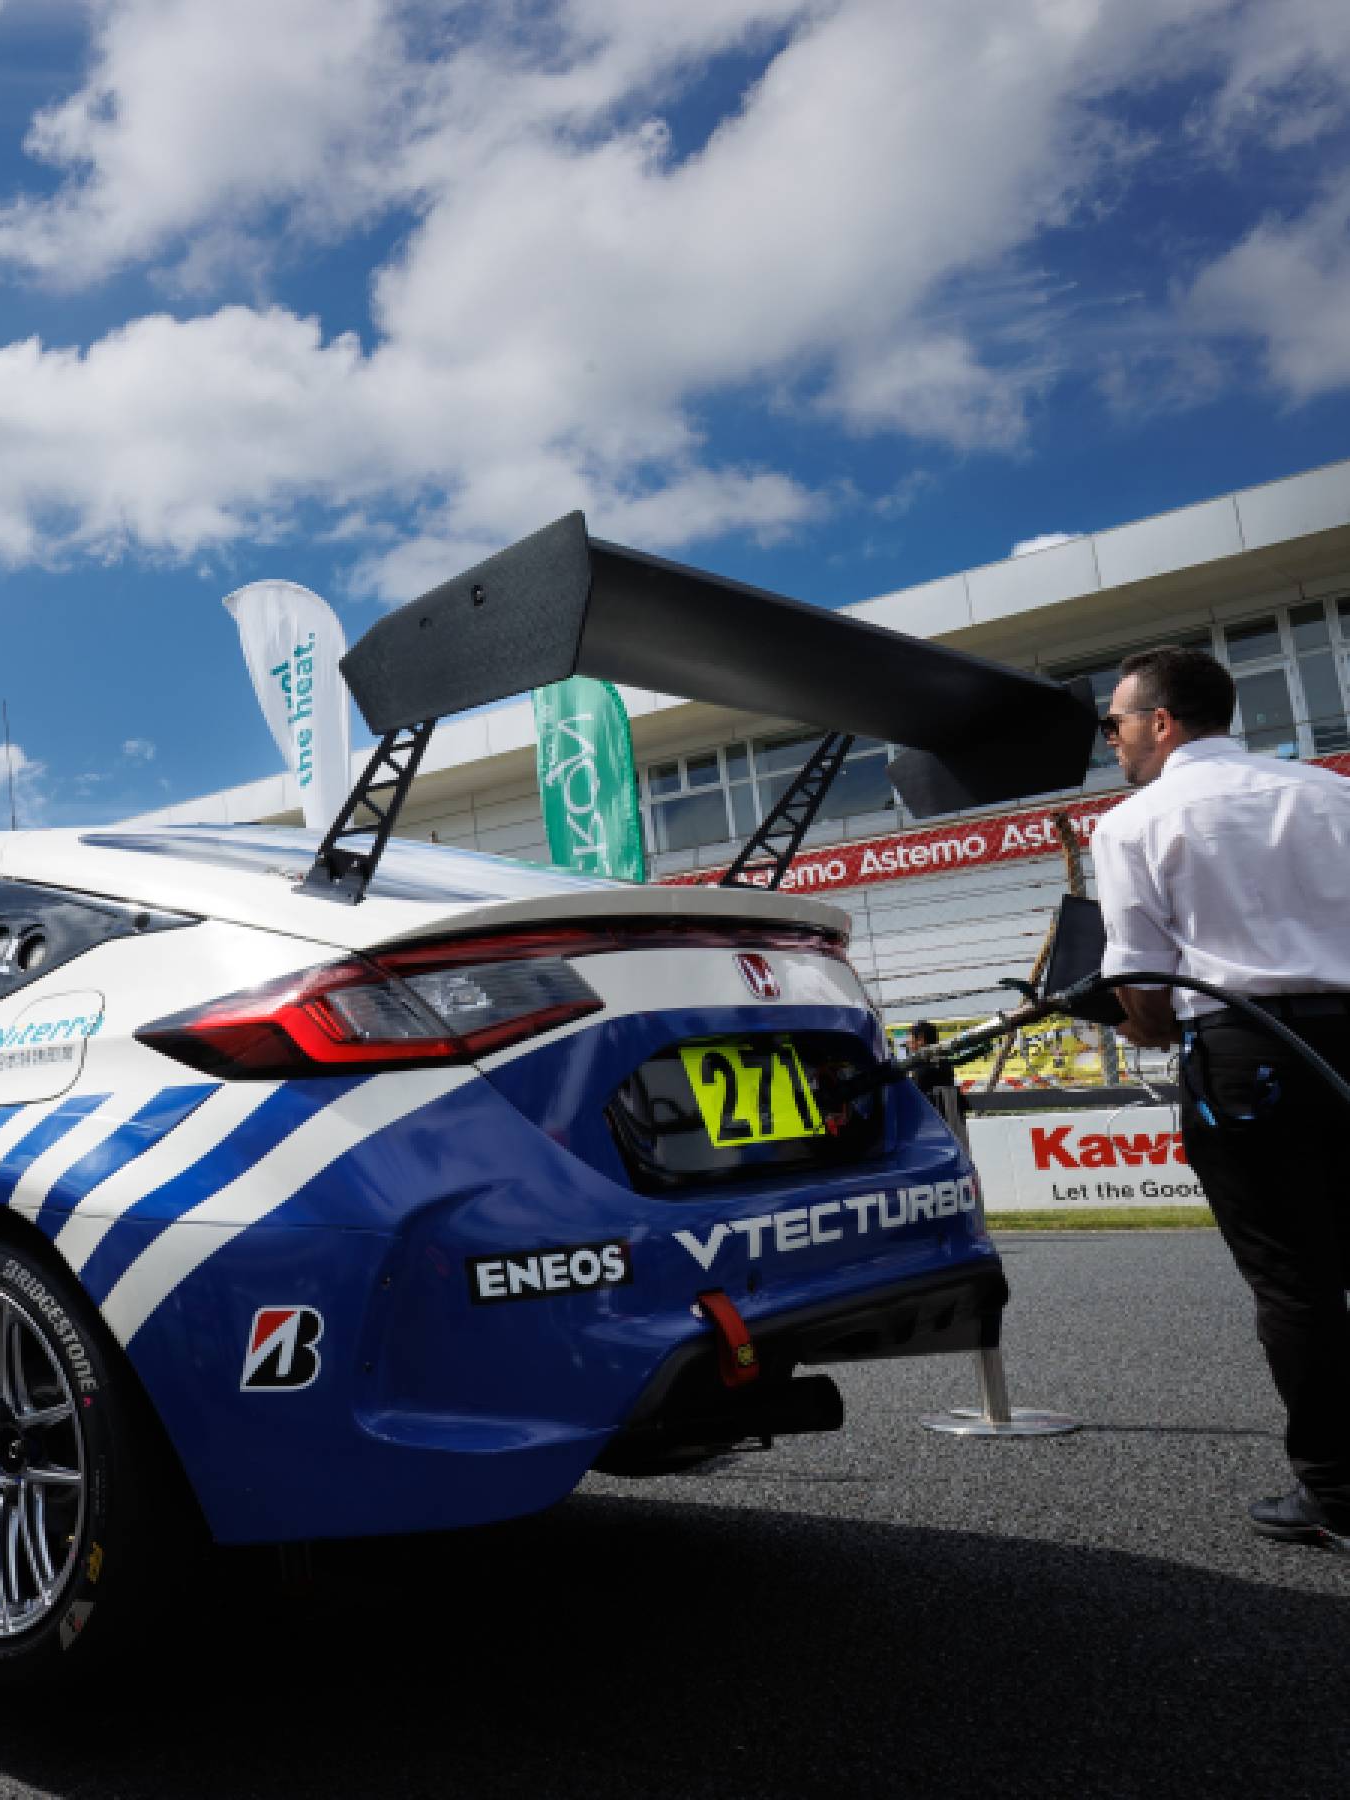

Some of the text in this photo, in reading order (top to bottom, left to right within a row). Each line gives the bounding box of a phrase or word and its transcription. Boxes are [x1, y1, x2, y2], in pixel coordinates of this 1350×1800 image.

[287, 632, 316, 726] heat.
[734, 860, 847, 890] stemo
[859, 829, 986, 875] Astemo
[701, 1046, 815, 1140] 271
[671, 1175, 977, 1272] VTEC TURBO
[1052, 1181, 1089, 1201] Let
[1096, 1181, 1134, 1199] the
[475, 1244, 626, 1297] ENEOS
[2, 1258, 100, 1394] BRIDGESTONE
